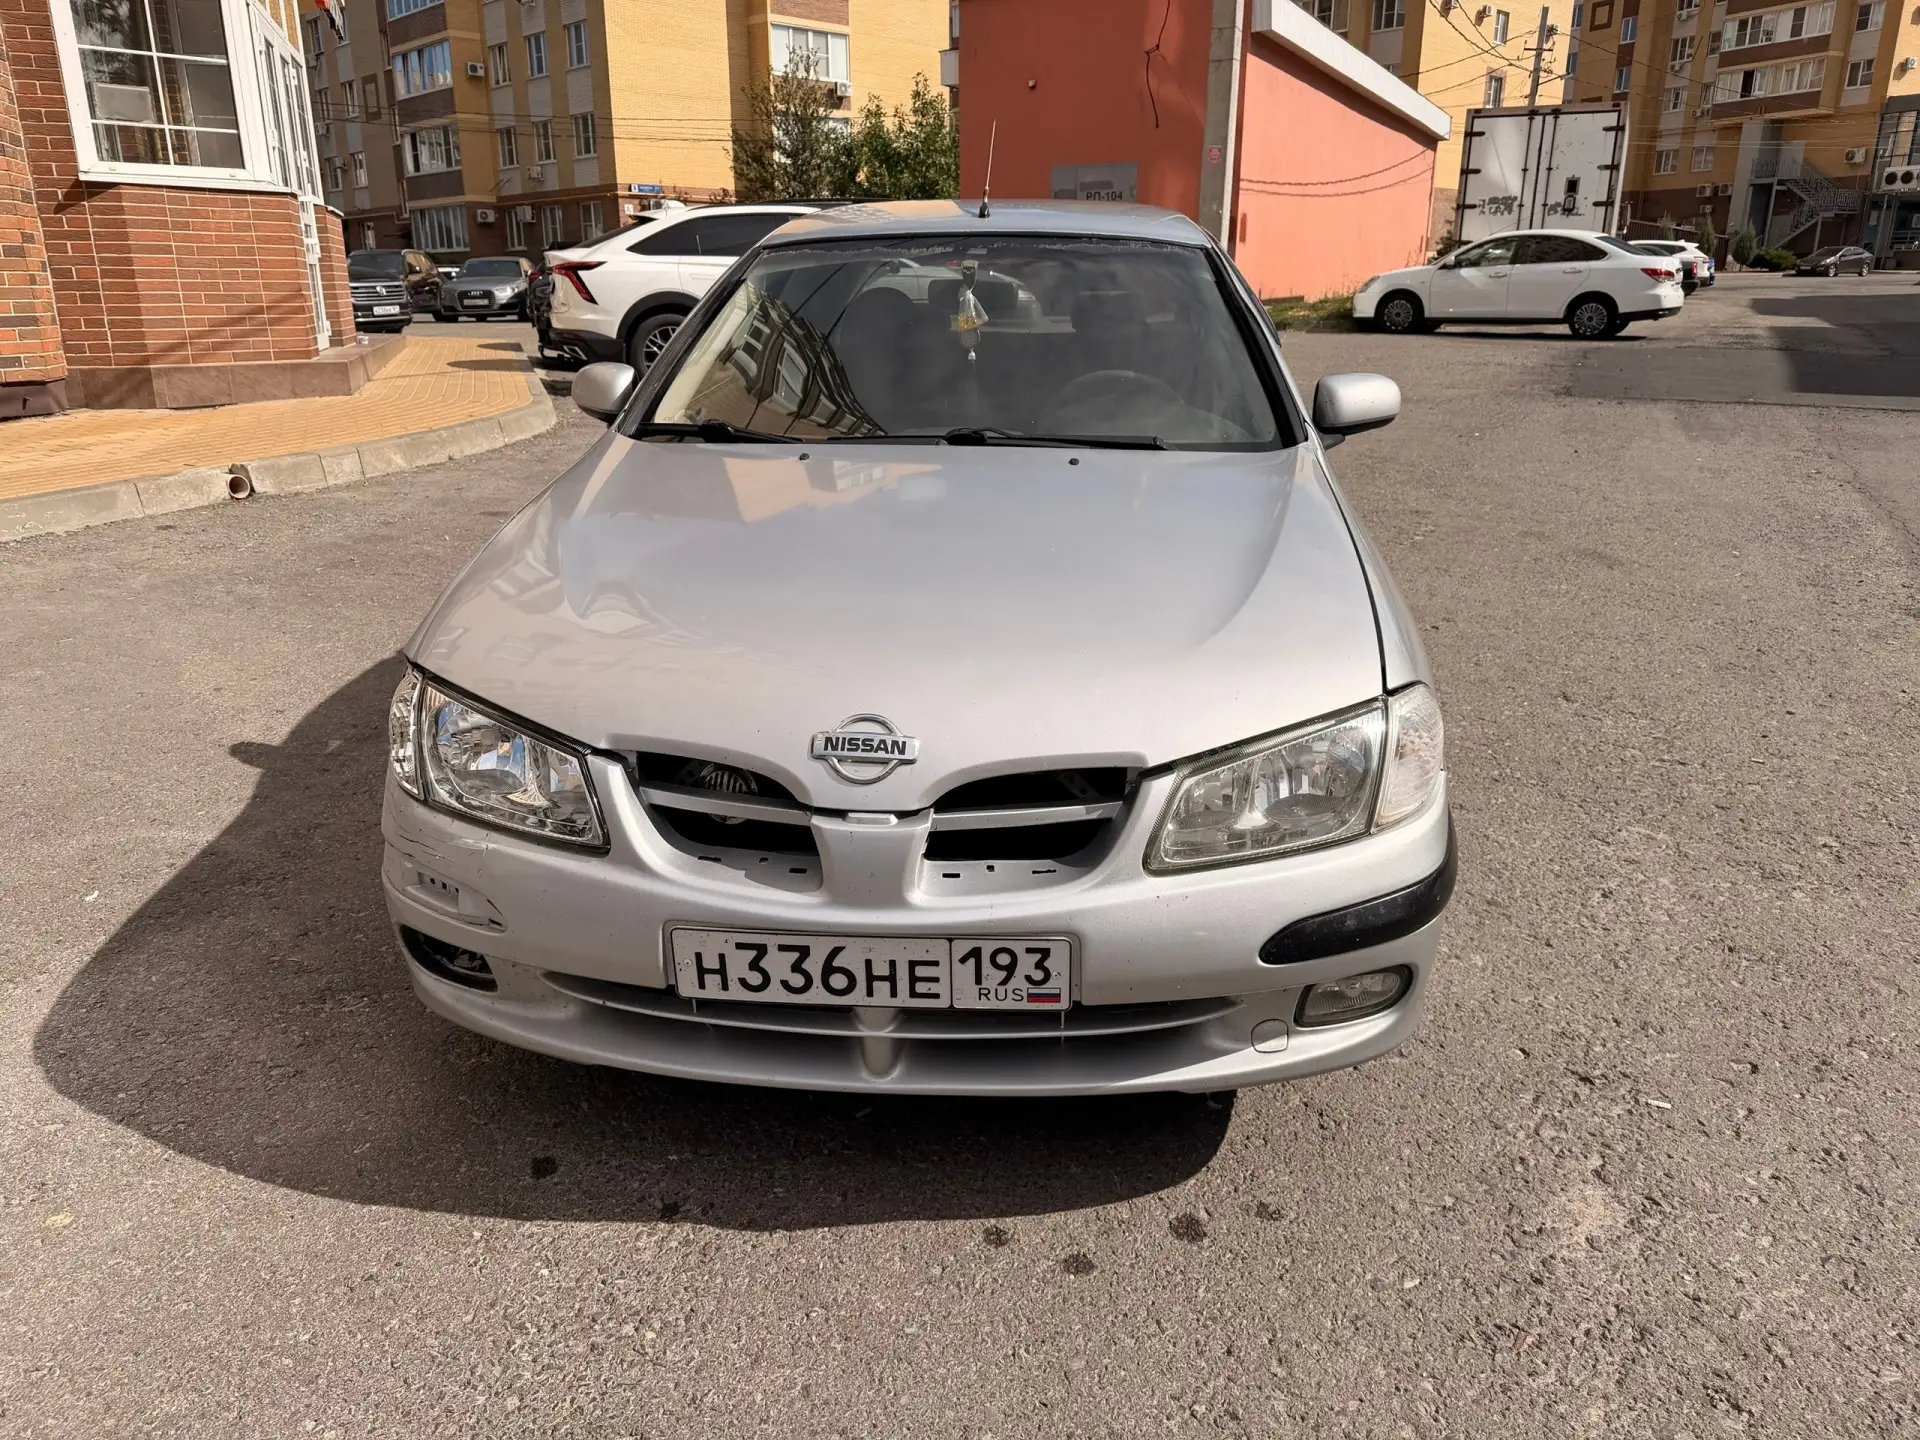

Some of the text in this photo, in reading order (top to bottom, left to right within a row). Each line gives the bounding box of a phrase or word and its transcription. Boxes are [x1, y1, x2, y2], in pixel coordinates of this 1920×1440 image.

[1086, 191, 1123, 201] РП-104
[823, 736, 907, 756] NISSAN
[694, 942, 1052, 999] Н336НЕ 193
[978, 987, 1025, 1002] RUS
